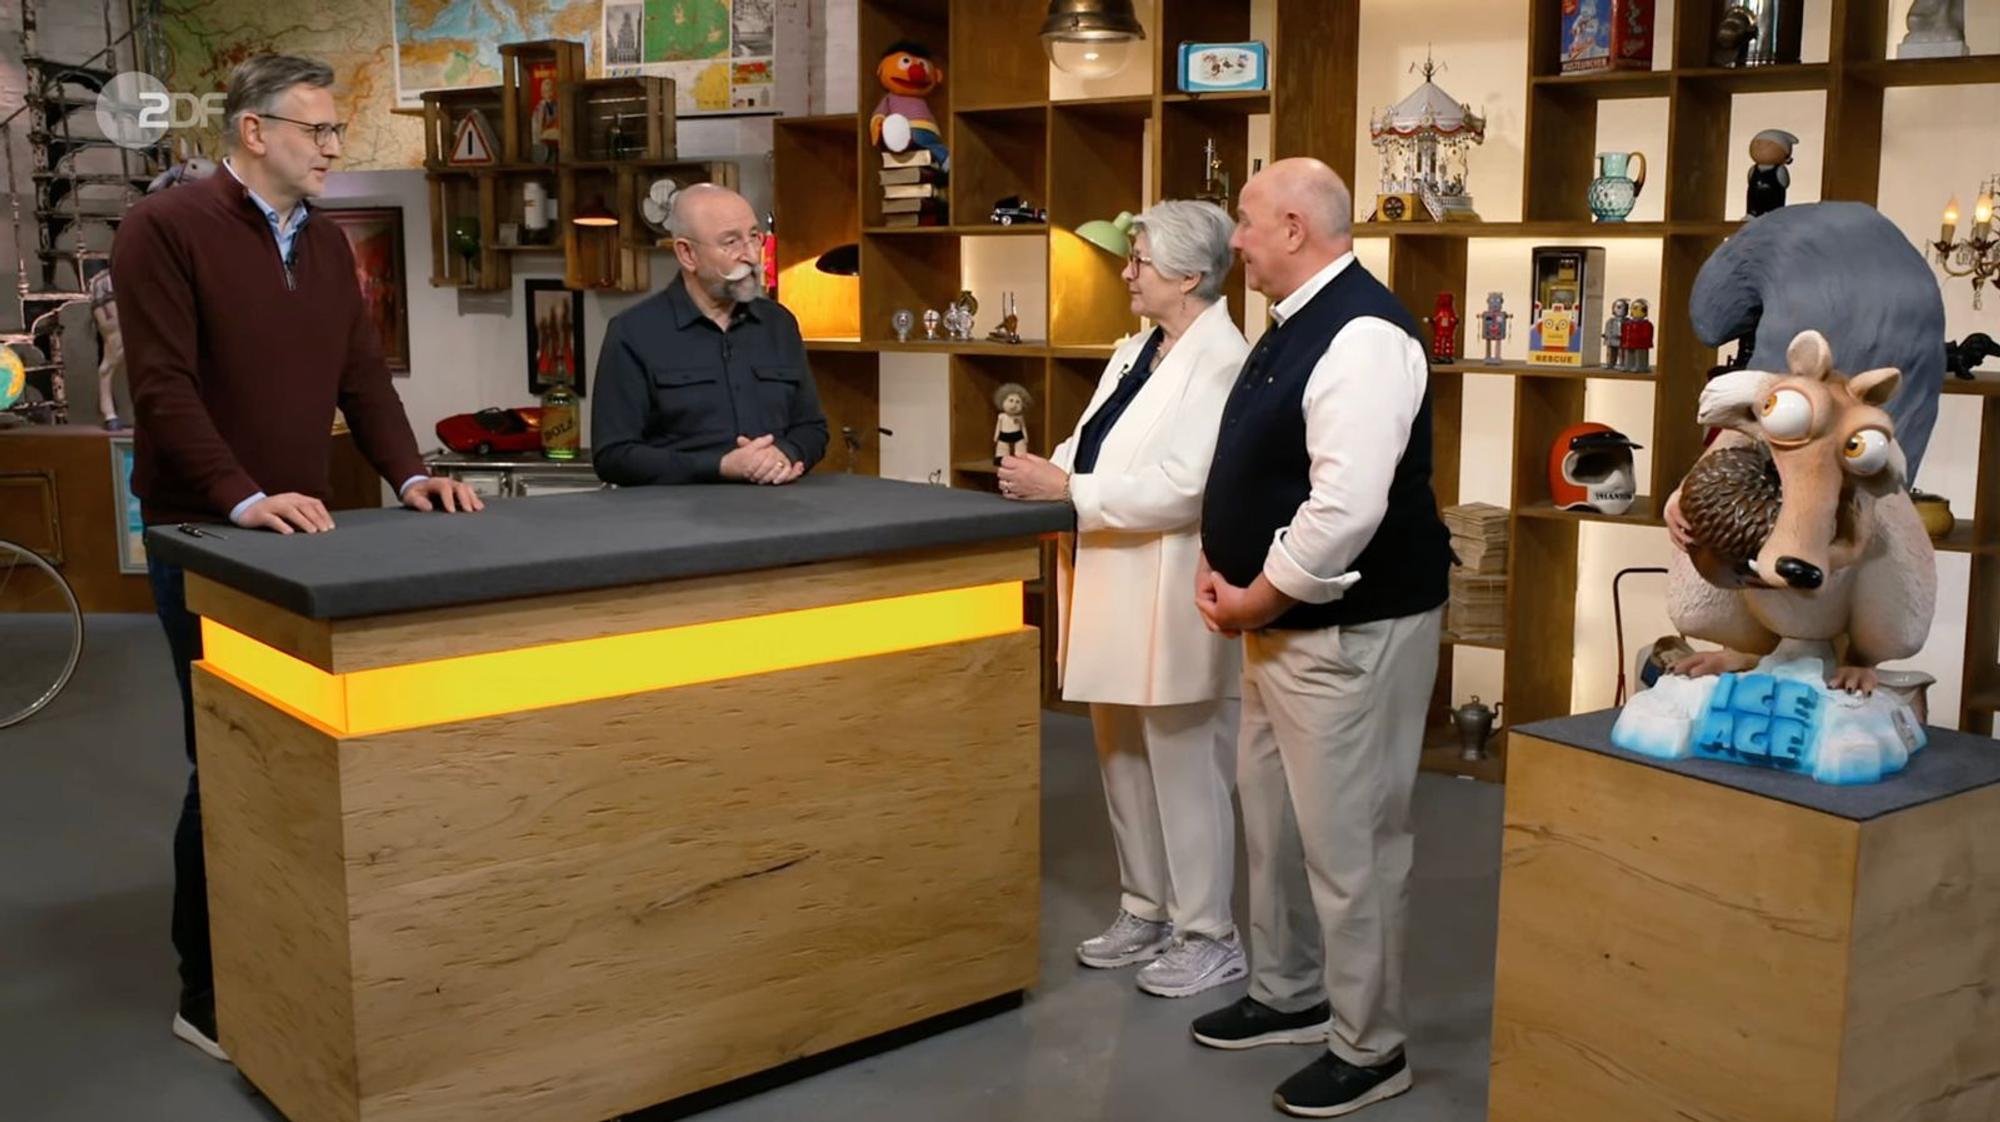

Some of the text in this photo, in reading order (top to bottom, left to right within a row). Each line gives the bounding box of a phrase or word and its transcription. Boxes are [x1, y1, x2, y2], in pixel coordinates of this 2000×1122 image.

[1535, 354, 1573, 364] RESCUE
[1711, 672, 1818, 720] ICE
[1700, 709, 1806, 764] AGE
